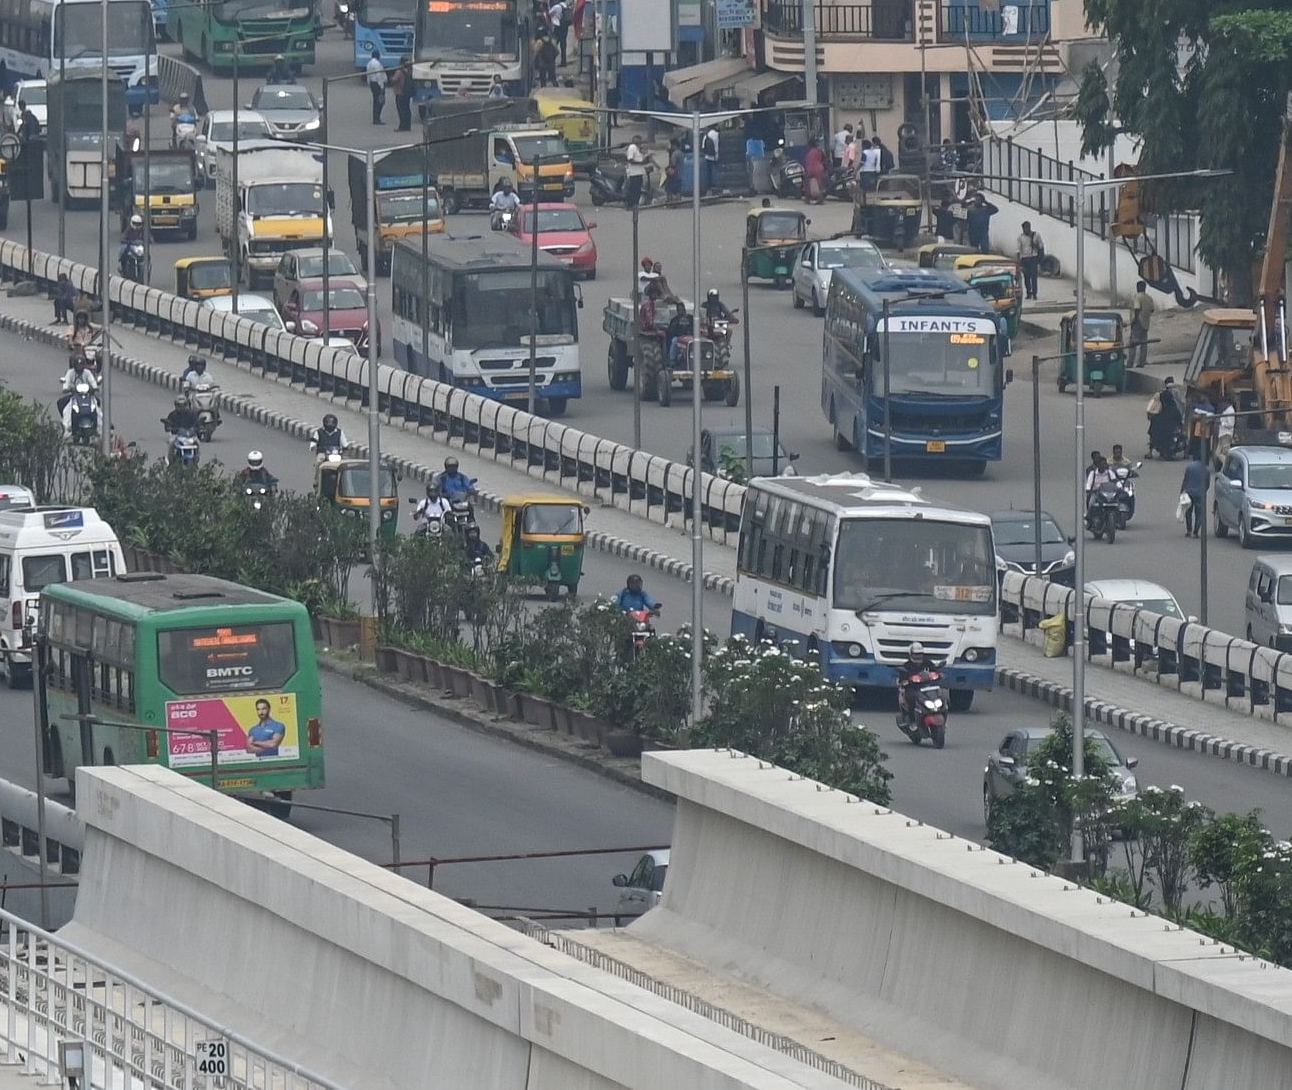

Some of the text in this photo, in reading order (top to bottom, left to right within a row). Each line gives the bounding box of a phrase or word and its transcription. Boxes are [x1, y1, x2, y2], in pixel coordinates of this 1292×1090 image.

[900, 320, 977, 332] INFANT'S
[206, 666, 253, 678] BMTC
[208, 1042, 225, 1058] 20
[199, 1059, 225, 1074] 400
